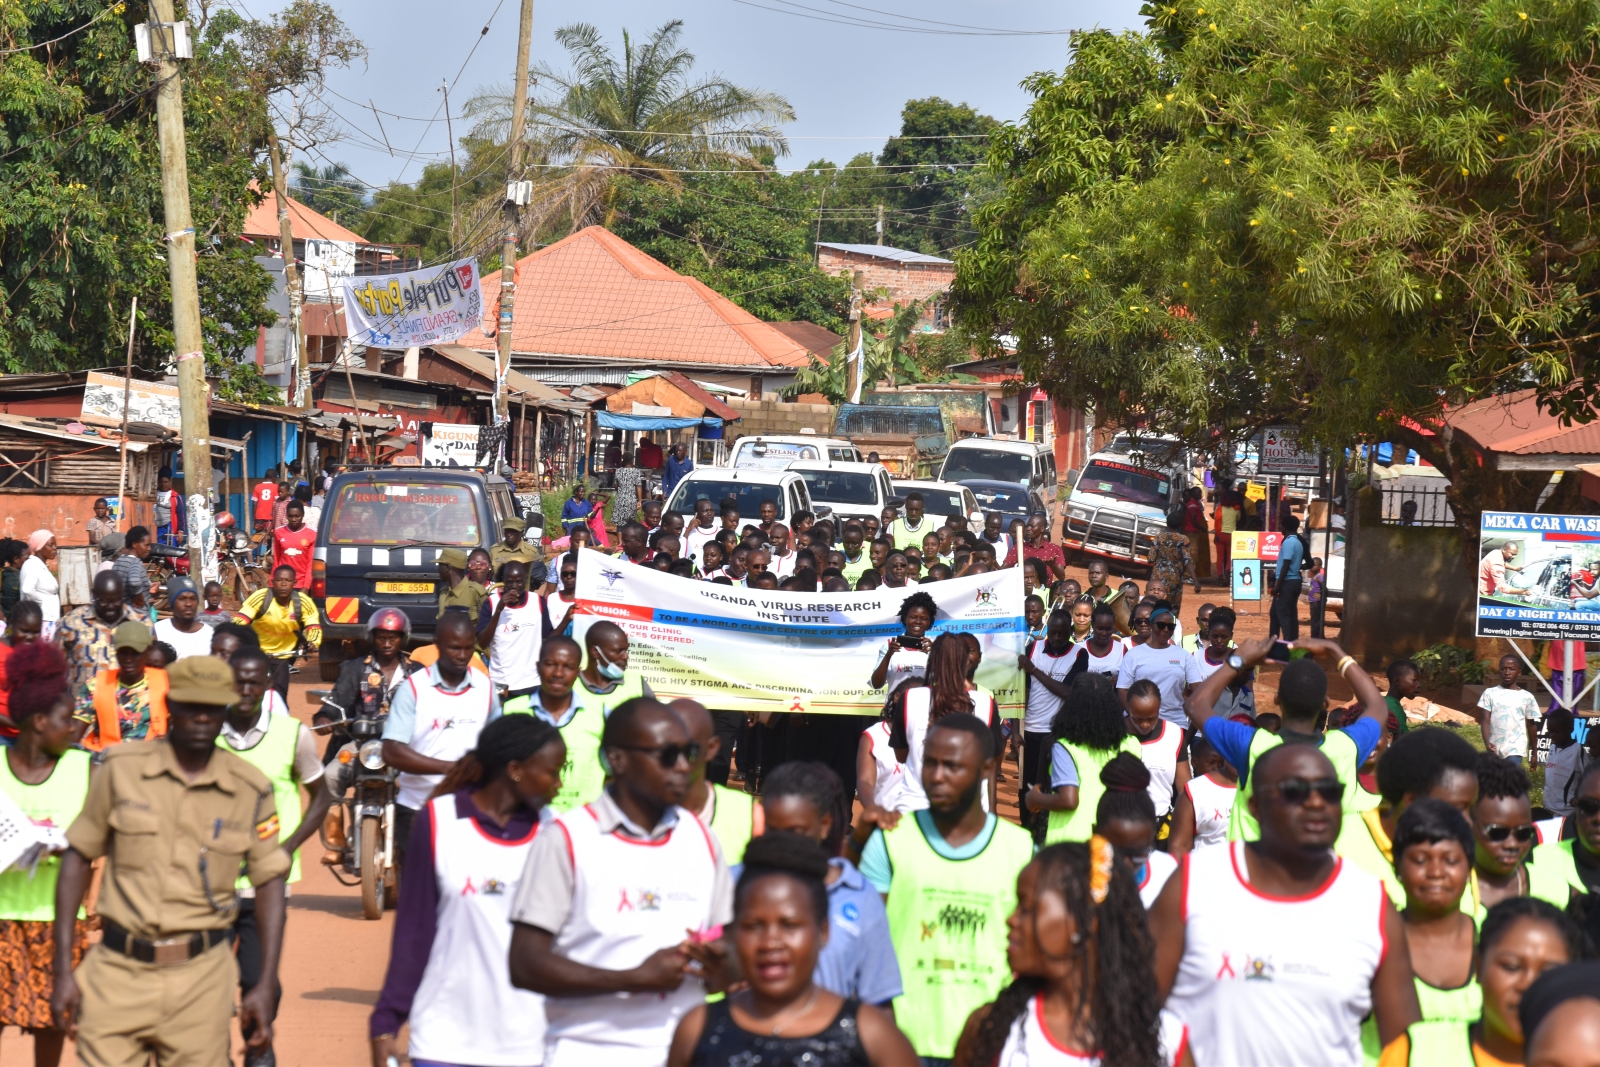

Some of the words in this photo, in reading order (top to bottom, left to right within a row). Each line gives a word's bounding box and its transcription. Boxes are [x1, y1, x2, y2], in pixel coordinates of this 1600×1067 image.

[764, 448, 798, 456] ESTLAKE
[1265, 448, 1298, 458] HOUS
[262, 488, 272, 500] 8
[1485, 515, 1528, 528] MEKA
[1530, 517, 1560, 530] CAR
[387, 584, 403, 592] UBC
[408, 584, 429, 592] 655A
[700, 590, 756, 608] UGANDA
[761, 600, 803, 612] VIRUS
[808, 601, 882, 612] RESEARCH
[592, 605, 630, 616] VISION:
[1480, 608, 1504, 616] DAY
[1506, 609, 1516, 618] &
[1518, 610, 1555, 619] NIGHT
[757, 611, 830, 624] INSTITUTE
[652, 626, 682, 635] CLINIC
[702, 618, 738, 629] WORLD
[741, 623, 774, 632] CLASS
[777, 626, 818, 635] CENTRE
[838, 627, 902, 636] EXCELLENCE
[962, 621, 1016, 631] RESEARCH
[650, 633, 694, 644] OFFERED:
[1533, 630, 1560, 638] Cleaning
[642, 666, 686, 674] Distribution
[670, 677, 688, 686] HIV
[690, 679, 728, 688] STIGMA
